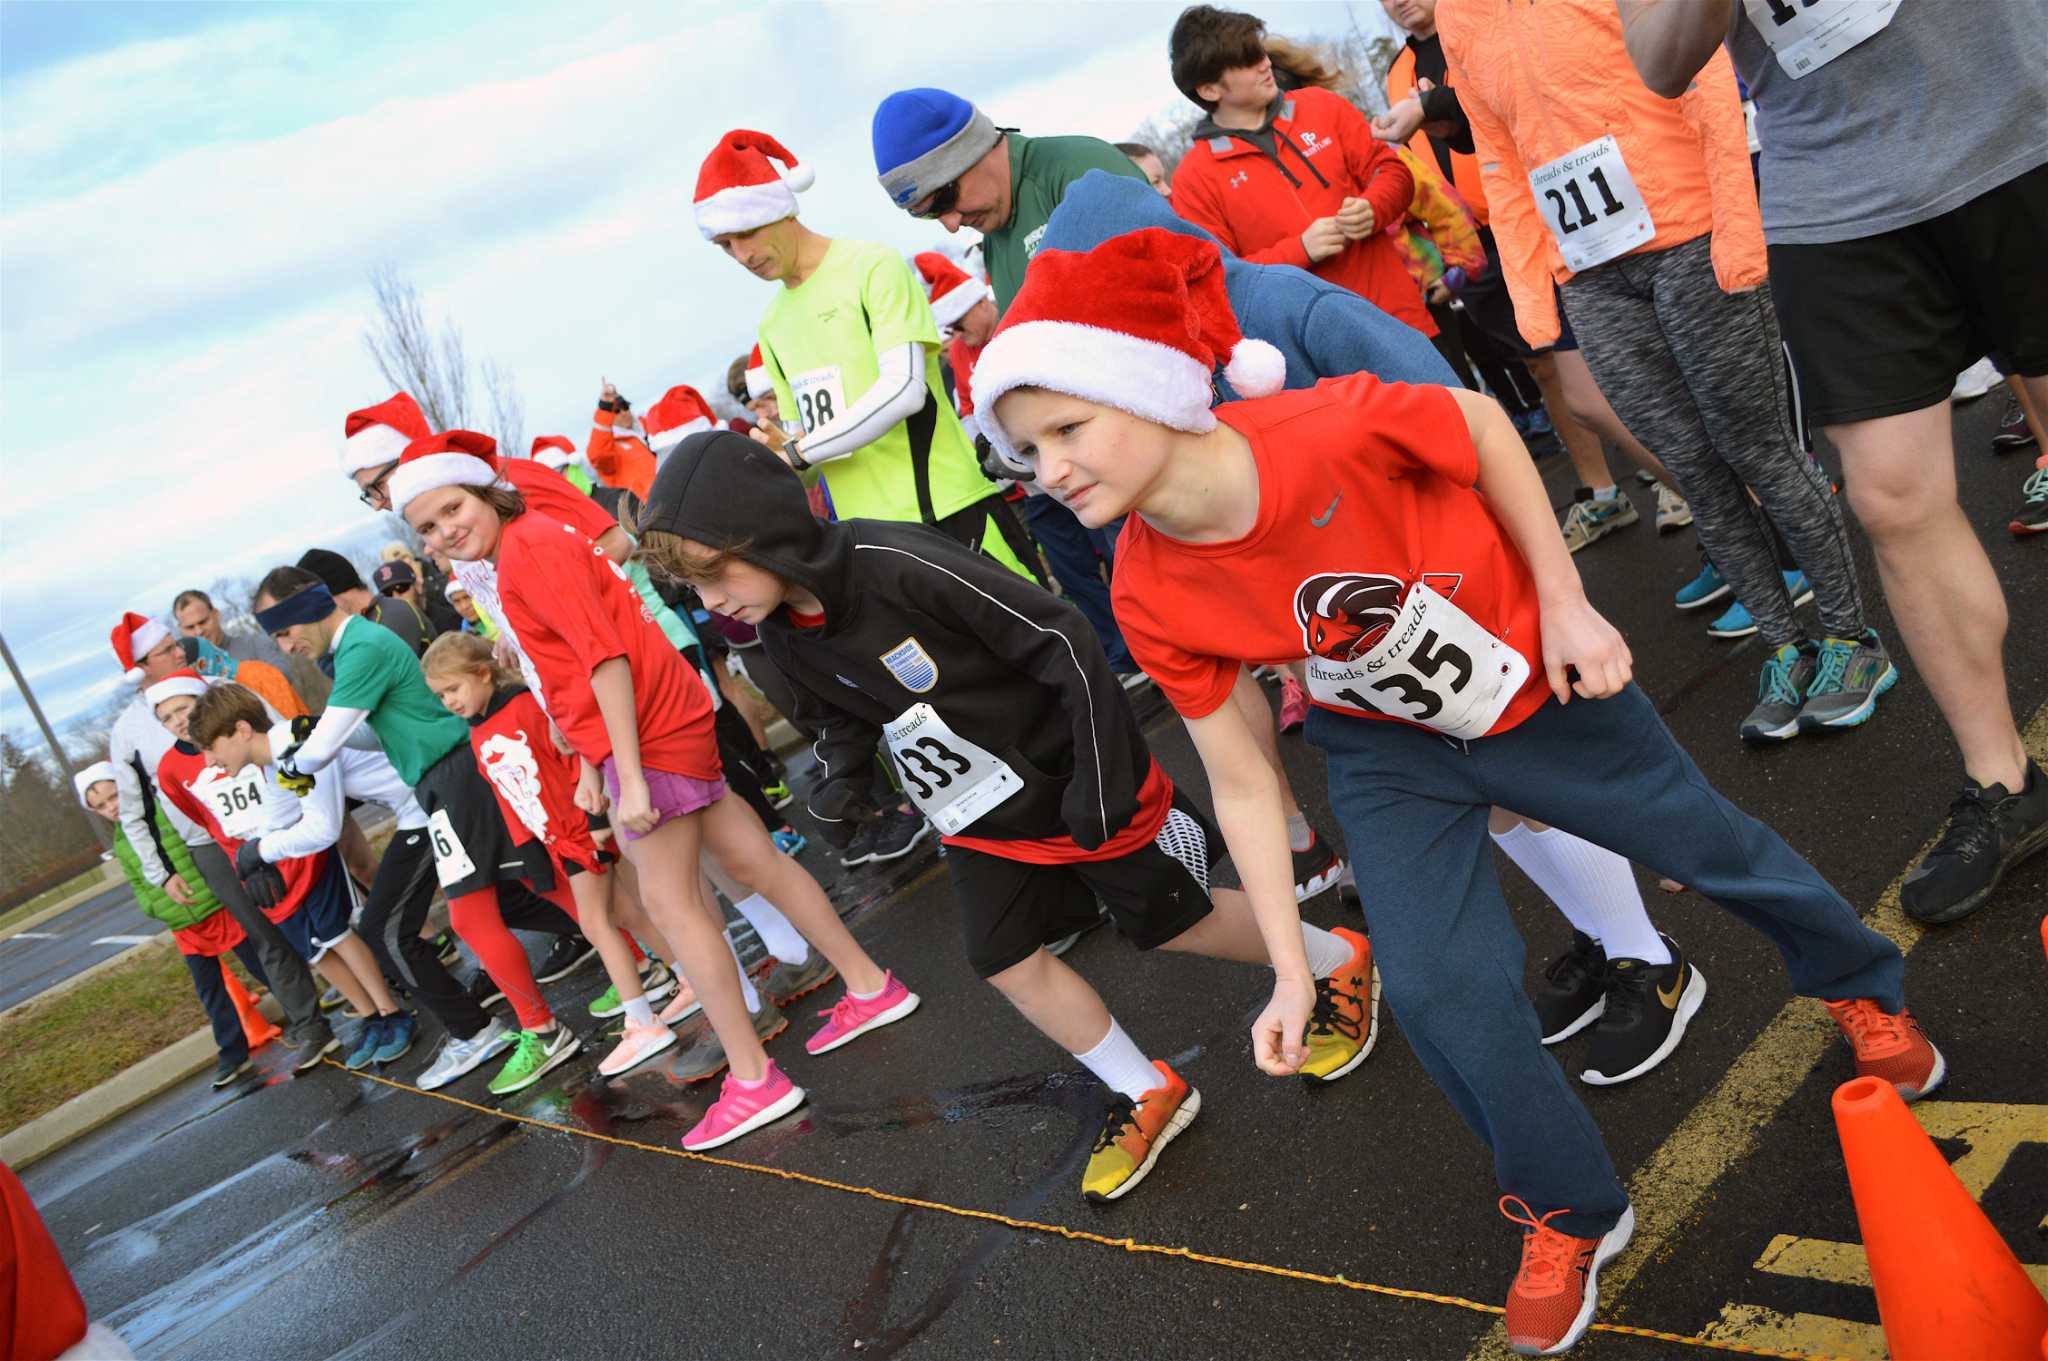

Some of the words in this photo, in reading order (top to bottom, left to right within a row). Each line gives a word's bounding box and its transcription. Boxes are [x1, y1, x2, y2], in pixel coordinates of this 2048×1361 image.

[1562, 161, 1574, 173] &
[1575, 143, 1610, 167] treads
[1543, 166, 1625, 235] 211
[1310, 664, 1364, 682] threads
[1366, 656, 1387, 673] &
[1388, 598, 1428, 659] treads
[1334, 628, 1473, 721] 135
[898, 711, 928, 738] treads
[216, 781, 263, 817] 364
[893, 736, 972, 800] 333
